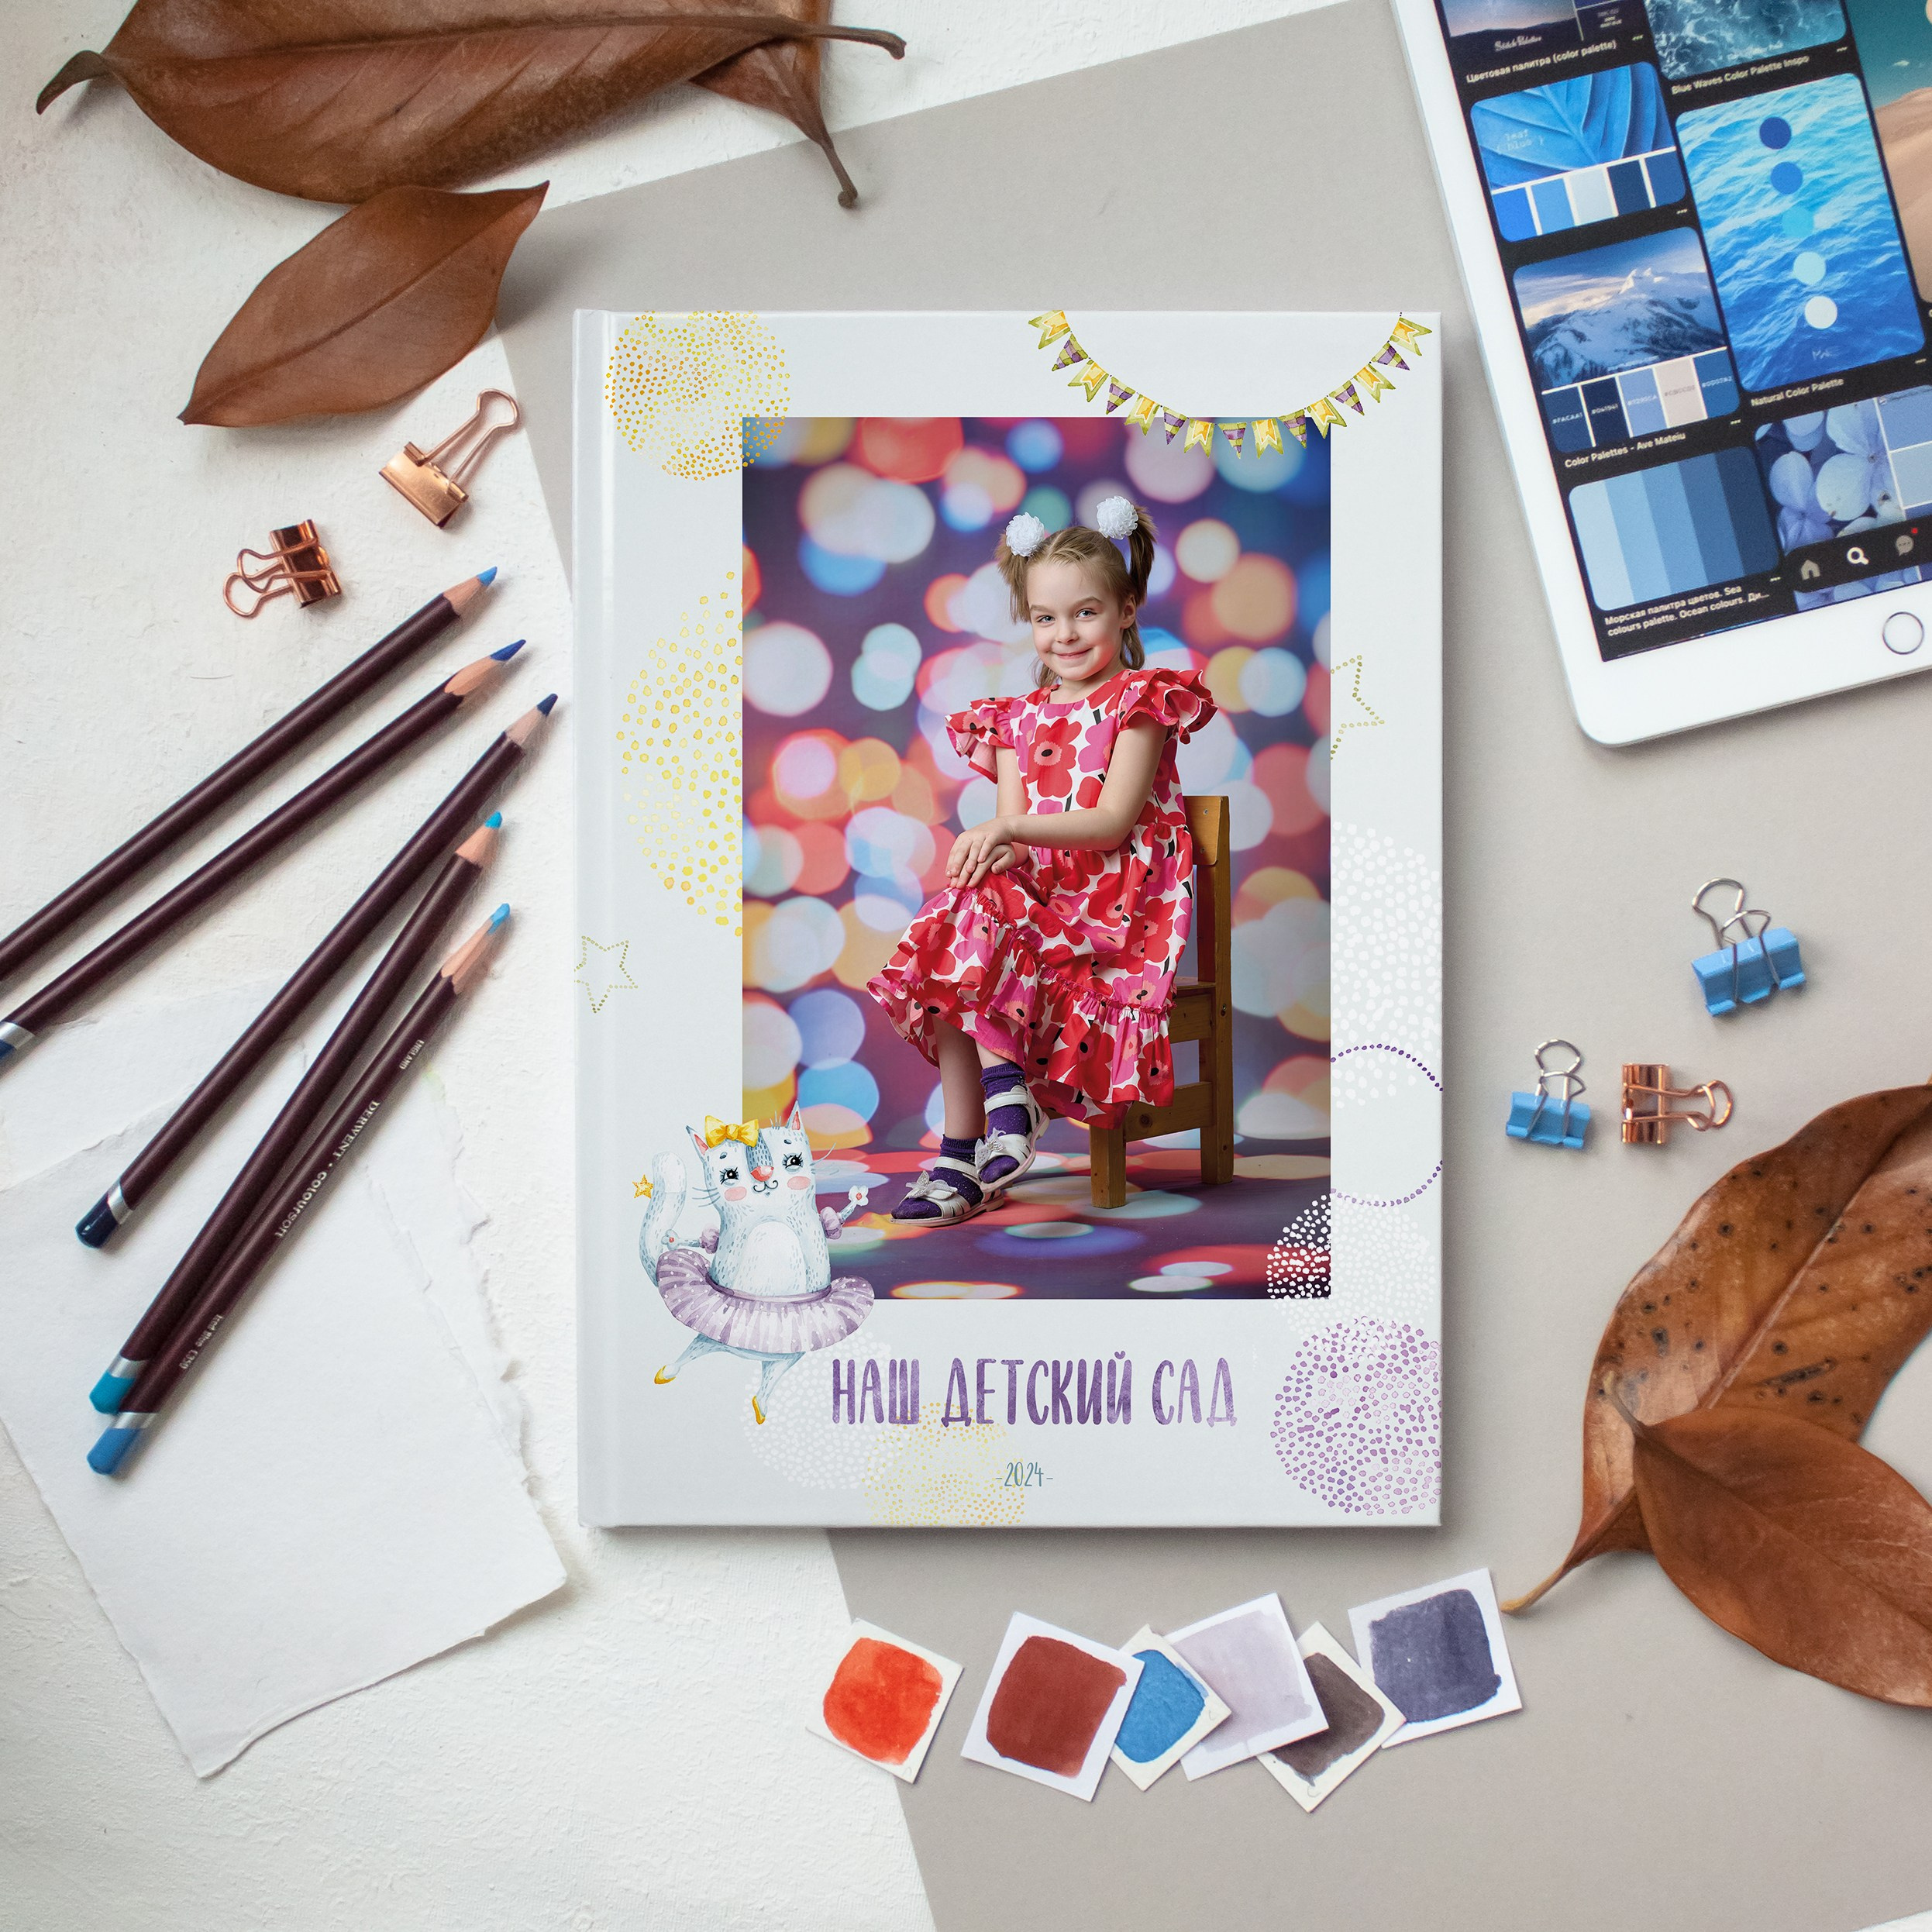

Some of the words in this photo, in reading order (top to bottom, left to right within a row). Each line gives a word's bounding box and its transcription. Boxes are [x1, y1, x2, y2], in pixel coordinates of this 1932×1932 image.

[1466, 67, 1510, 83] Цветовая
[1512, 57, 1551, 72] палитра
[1553, 50, 1579, 64] (color
[1581, 40, 1617, 56] palette)
[1672, 84, 1692, 95] Blue
[1693, 75, 1724, 88] Waves
[1724, 69, 1748, 82] Color
[1750, 62, 1782, 76] Palette
[1751, 392, 1785, 407] Natural
[1786, 387, 1810, 398] Color
[1812, 378, 1844, 392] Palette
[1565, 456, 1589, 468] Color
[1591, 446, 1628, 462] Palettes
[1637, 440, 1654, 451] Ave
[1604, 610, 1646, 625] Морская
[1648, 599, 1686, 615] палитра
[1688, 593, 1723, 606] цветов.
[1724, 584, 1742, 596] Sea
[1607, 622, 1641, 637] colours
[1643, 613, 1678, 629] palette.
[1679, 606, 1708, 619] Ocean
[1710, 597, 1746, 611] colours.
[332, 1100, 381, 1160] DERWENT
[832, 1359, 920, 1425] НАШ
[941, 1350, 1133, 1428] ДЕТСКИЙ
[1152, 1357, 1238, 1428] САД
